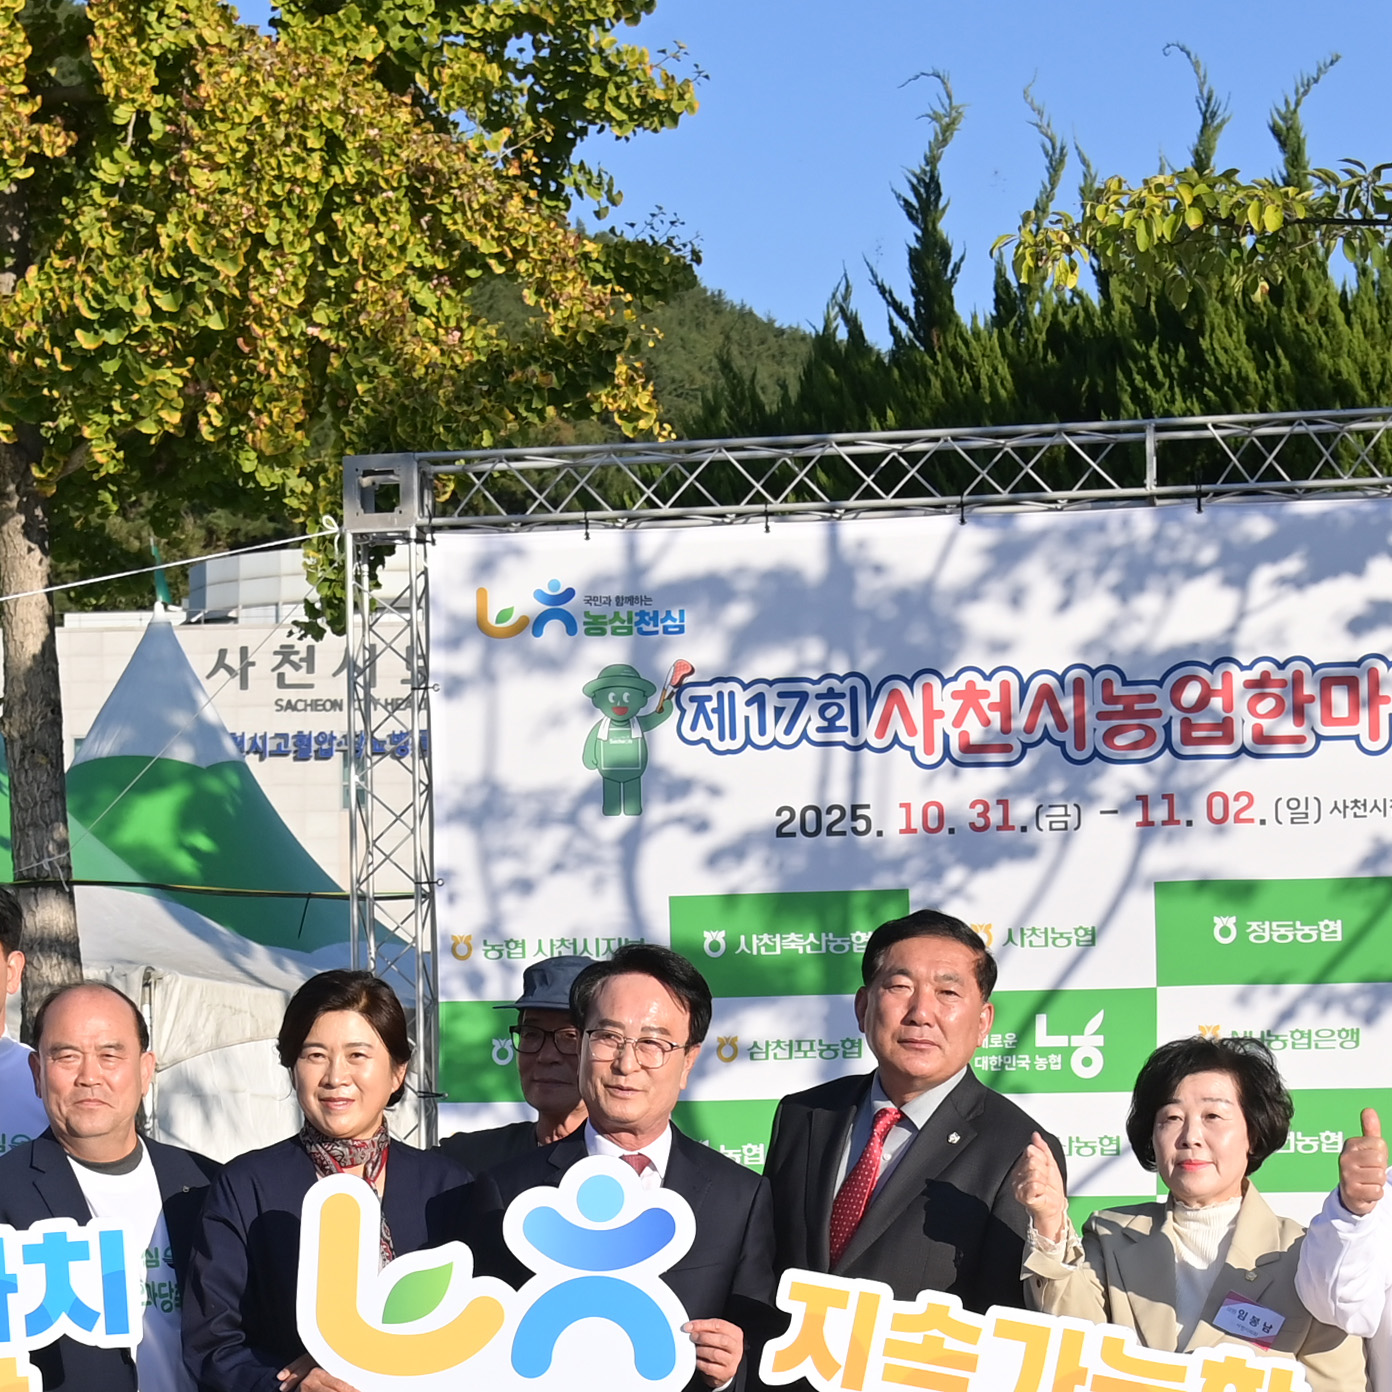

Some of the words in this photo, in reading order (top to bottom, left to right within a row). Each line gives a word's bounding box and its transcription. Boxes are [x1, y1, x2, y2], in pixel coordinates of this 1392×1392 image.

[583, 595, 612, 607] 국민과
[615, 594, 653, 607] 함께하는
[583, 609, 685, 637] 농심천심
[275, 698, 343, 712] SACHEON
[687, 684, 860, 743] 제17회
[776, 803, 884, 838] 2025.
[898, 801, 956, 834] 10.
[1135, 793, 1194, 828] 11.
[735, 930, 872, 956] 사천축산농협
[1002, 925, 1097, 948] 사천농협
[1245, 919, 1343, 943] 정동농협
[482, 938, 526, 960] 농협
[747, 1037, 863, 1061] 삼천포농협
[974, 1053, 1031, 1071] 대한민국
[1034, 1053, 1062, 1071] 농협
